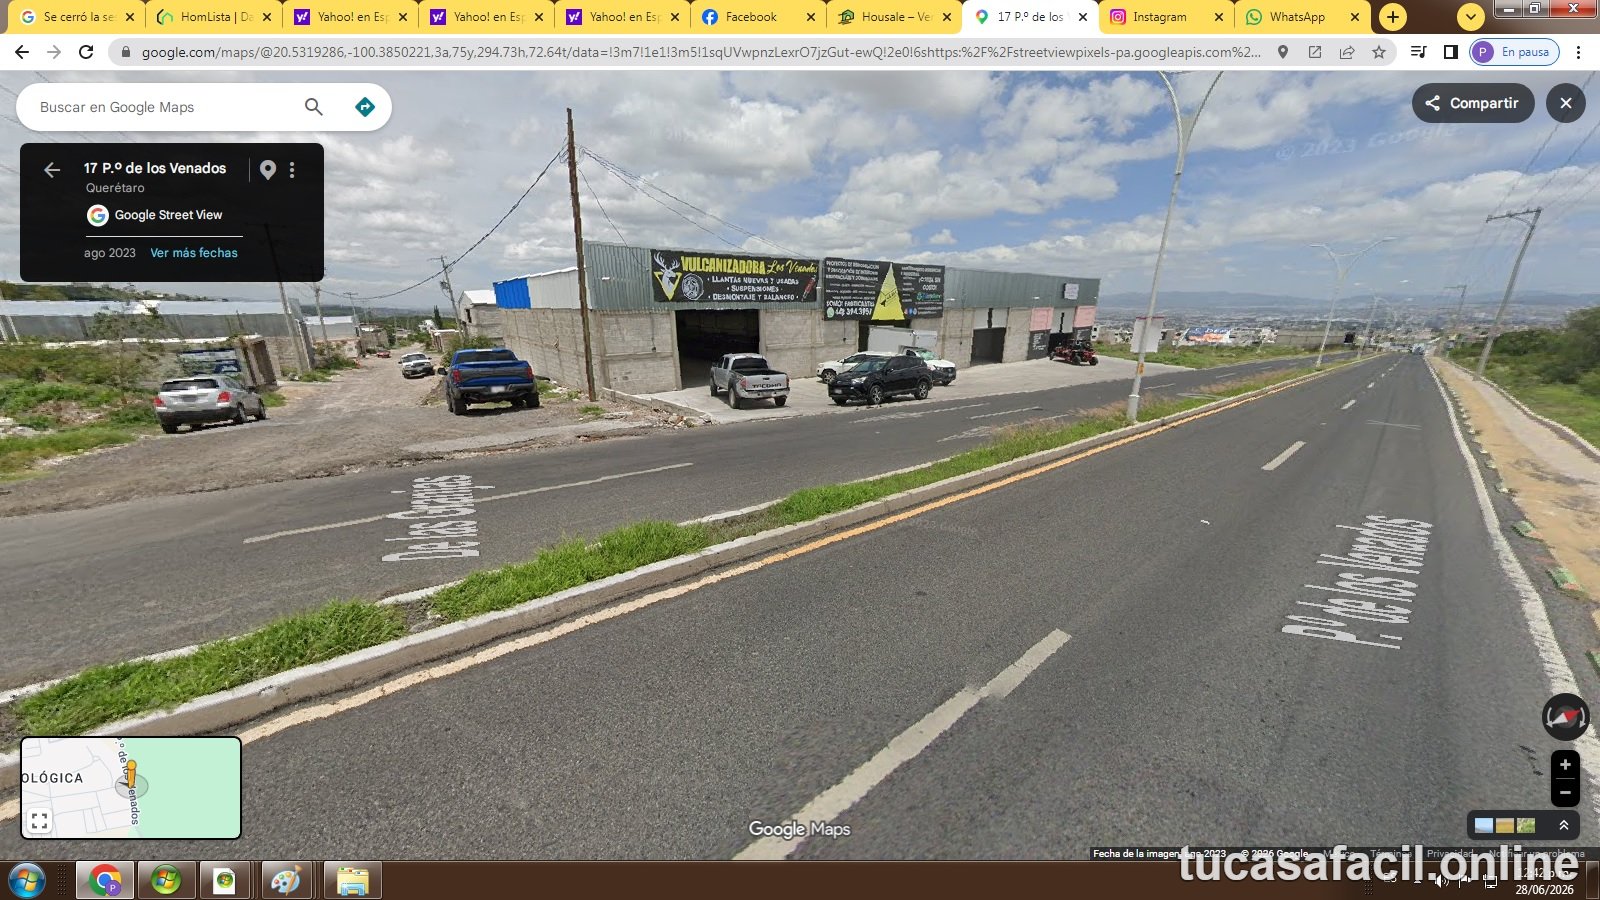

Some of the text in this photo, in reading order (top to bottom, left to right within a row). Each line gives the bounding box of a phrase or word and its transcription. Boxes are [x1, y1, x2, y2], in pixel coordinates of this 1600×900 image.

[44, 11, 117, 22] Se cerró la se
[181, 11, 231, 22] HomLista
[318, 12, 354, 22] Yahoo!
[357, 14, 371, 22] en
[454, 12, 490, 22] Yahoo!
[493, 14, 507, 22] en
[590, 12, 626, 22] Yahoo!
[629, 14, 643, 22] en
[726, 11, 776, 22] Facebook
[862, 11, 905, 22] Housale
[998, 12, 1011, 22] 17
[1031, 11, 1046, 22] de
[1049, 11, 1064, 22] los
[1133, 12, 1187, 25] Instagram
[1270, 11, 1325, 24] WhatsApp
[1502, 46, 1549, 60] En pausa
[40, 101, 195, 116] Buscar en Google Maps
[1450, 96, 1519, 112] Compartir
[84, 162, 97, 174] 17
[125, 162, 143, 174] de
[146, 162, 167, 174] los
[169, 162, 227, 174] Venados
[85, 181, 145, 195] Querétaro
[114, 209, 223, 223] Google Street View
[84, 247, 136, 261] ago 2023
[150, 246, 238, 258] Ver más fechas
[680, 256, 766, 275] VULCANIZADORA
[767, 260, 785, 274] Los
[711, 275, 741, 284] LLANTAS
[743, 277, 769, 285] NUEVAS
[731, 284, 779, 293] SUSPENSIONES
[712, 293, 756, 301] DESMONTAJE
[763, 293, 795, 301] BALANCEO
[117, 750, 128, 764] de
[128, 787, 141, 825] enados
[1093, 849, 1121, 858] Fecha
[1122, 849, 1134, 858] de
[1136, 849, 1144, 858] la
[1146, 849, 1181, 860] imagen
[1204, 849, 1227, 858] 2023
[1369, 848, 1413, 858] Téinos
[1540, 849, 1586, 860] problma
[1515, 884, 1575, 896] 28/06/2026
